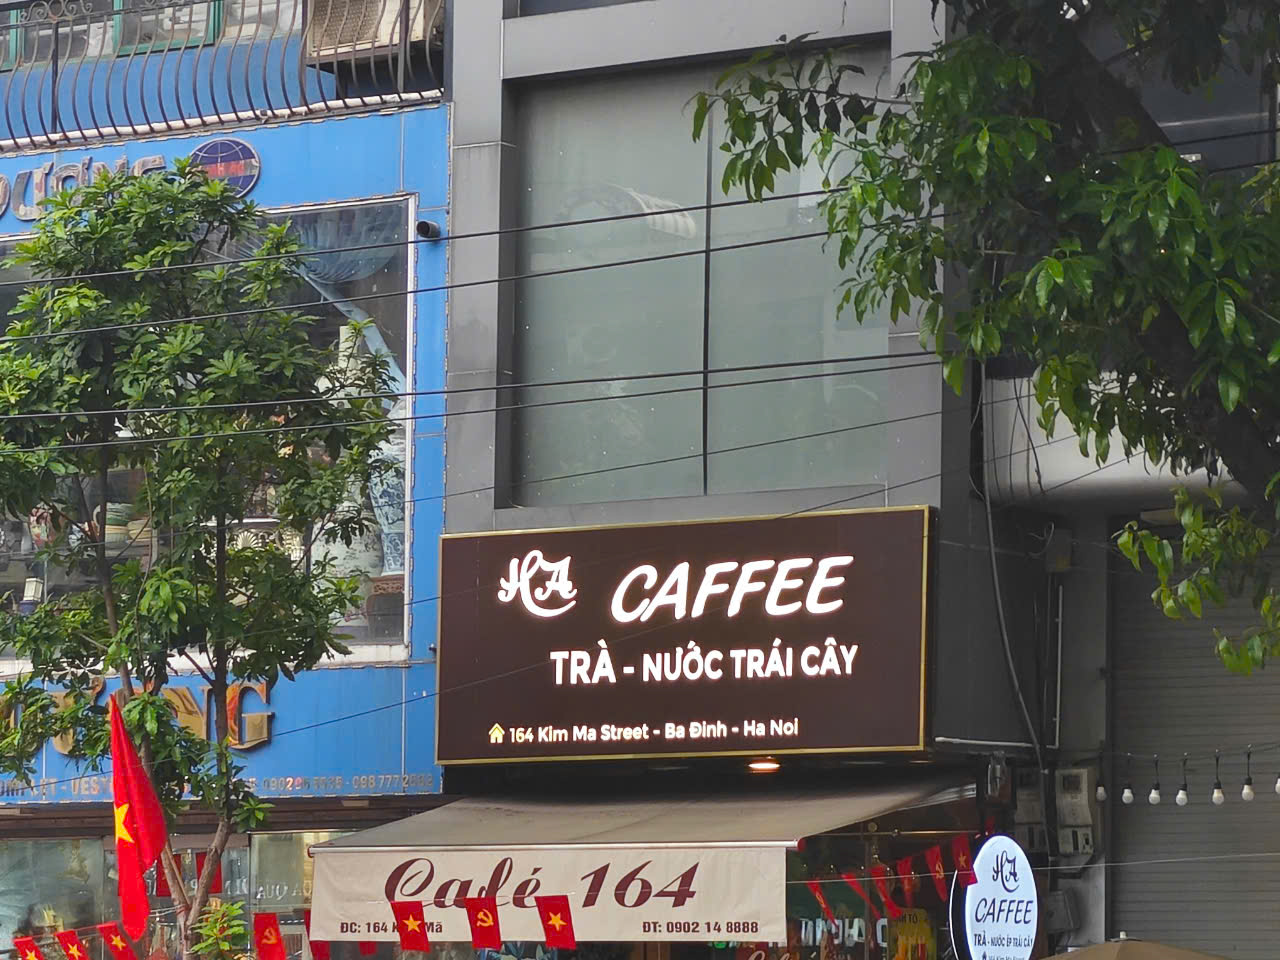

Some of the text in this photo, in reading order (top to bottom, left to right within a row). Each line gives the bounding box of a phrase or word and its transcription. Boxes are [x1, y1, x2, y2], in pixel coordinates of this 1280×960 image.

[610, 555, 855, 625] CAFFEE
[550, 638, 617, 686] TRÀ
[642, 640, 724, 683] NƯỚC
[729, 637, 793, 680] TRÁI
[800, 636, 859, 676] CÂY
[509, 725, 534, 743] 164
[537, 724, 569, 743] Kim
[572, 725, 597, 742] Ma
[600, 722, 650, 741] Street
[664, 721, 686, 740] Ba
[743, 719, 766, 737] Ha
[769, 717, 799, 736] Noi
[579, 861, 701, 909] 164
[975, 898, 1033, 924] CAFFEE
[340, 922, 361, 933] ĐC:
[365, 922, 388, 933] 164
[642, 921, 759, 934] ĐT: 0902 14 8888
[974, 931, 986, 946] TRÀ
